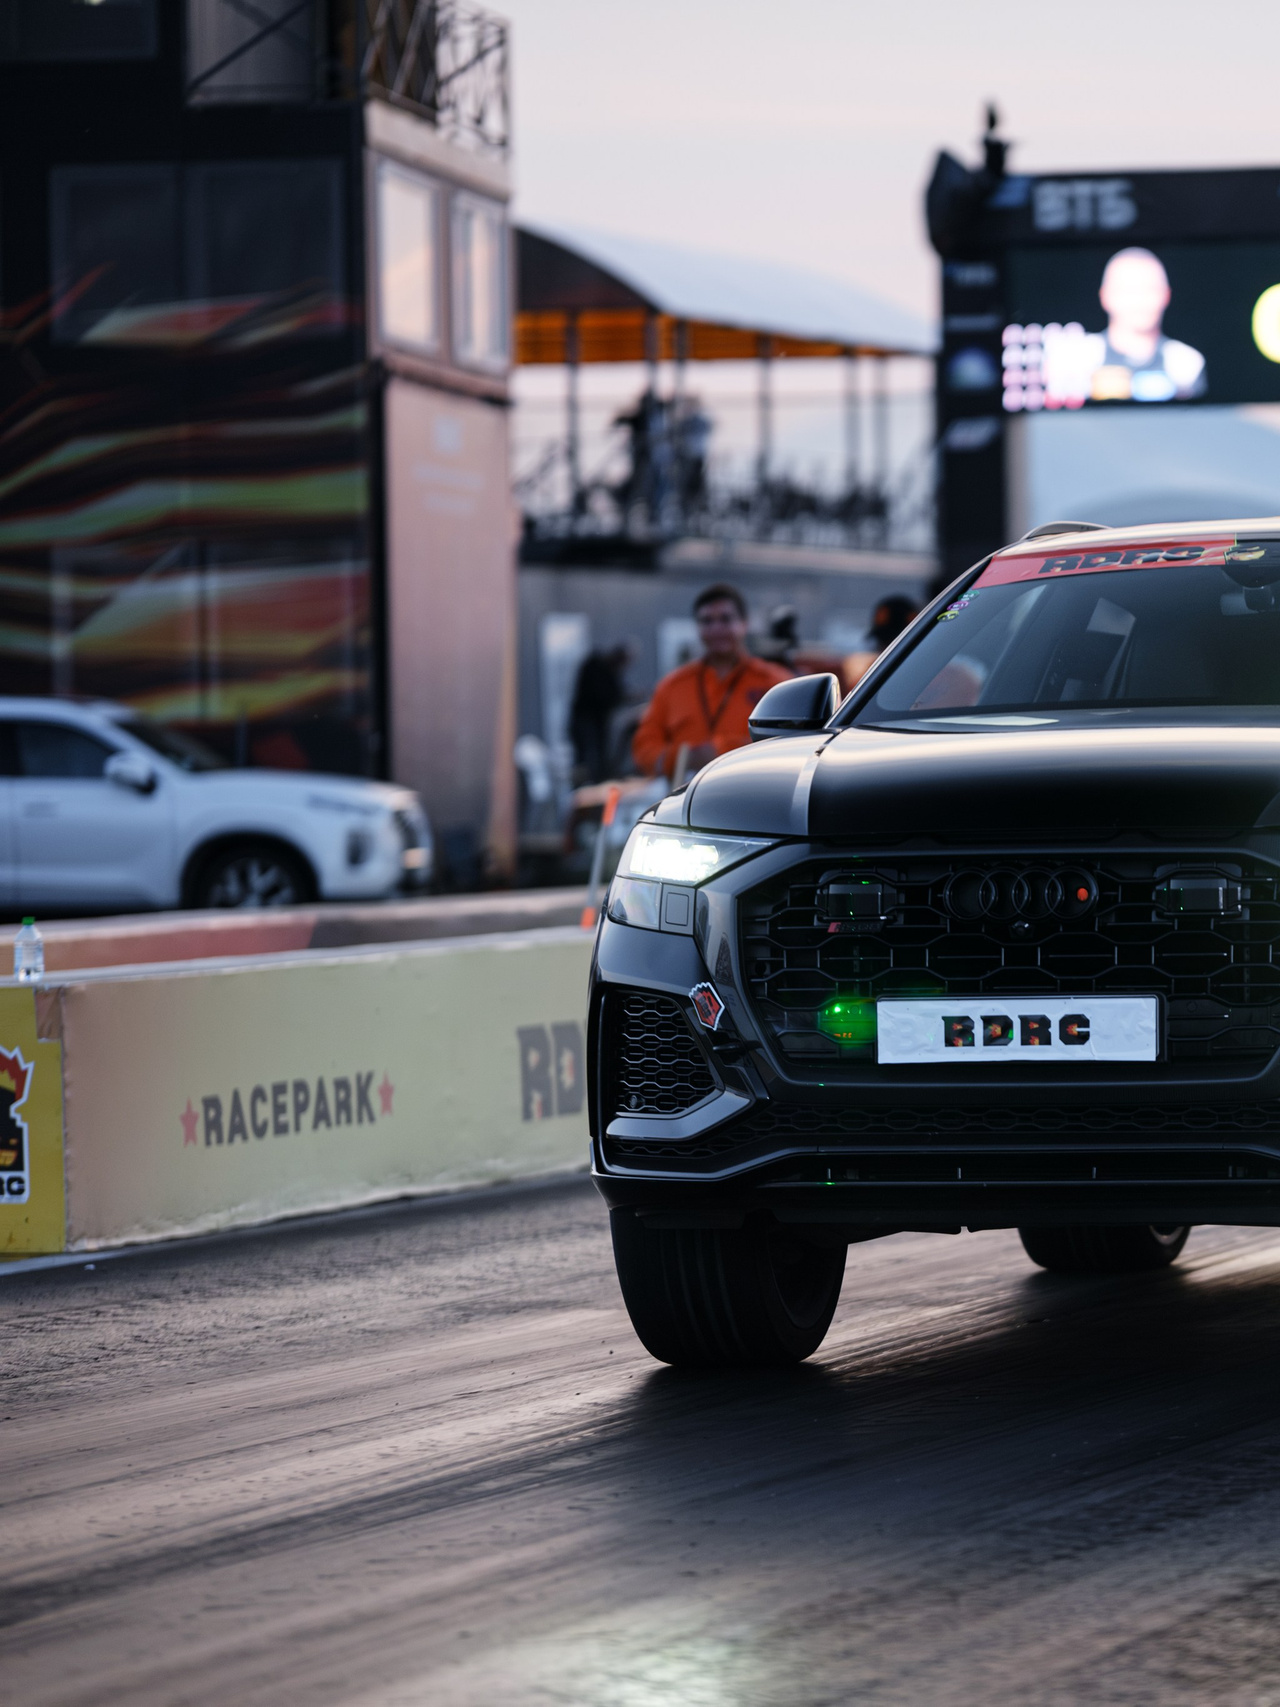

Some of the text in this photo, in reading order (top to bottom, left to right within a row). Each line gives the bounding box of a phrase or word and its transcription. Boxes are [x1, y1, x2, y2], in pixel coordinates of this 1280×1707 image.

[1033, 179, 1137, 231] ВТБ
[941, 1013, 1090, 1047] RDRC
[516, 1020, 586, 1122] RD
[201, 1071, 376, 1147] RACEPARK
